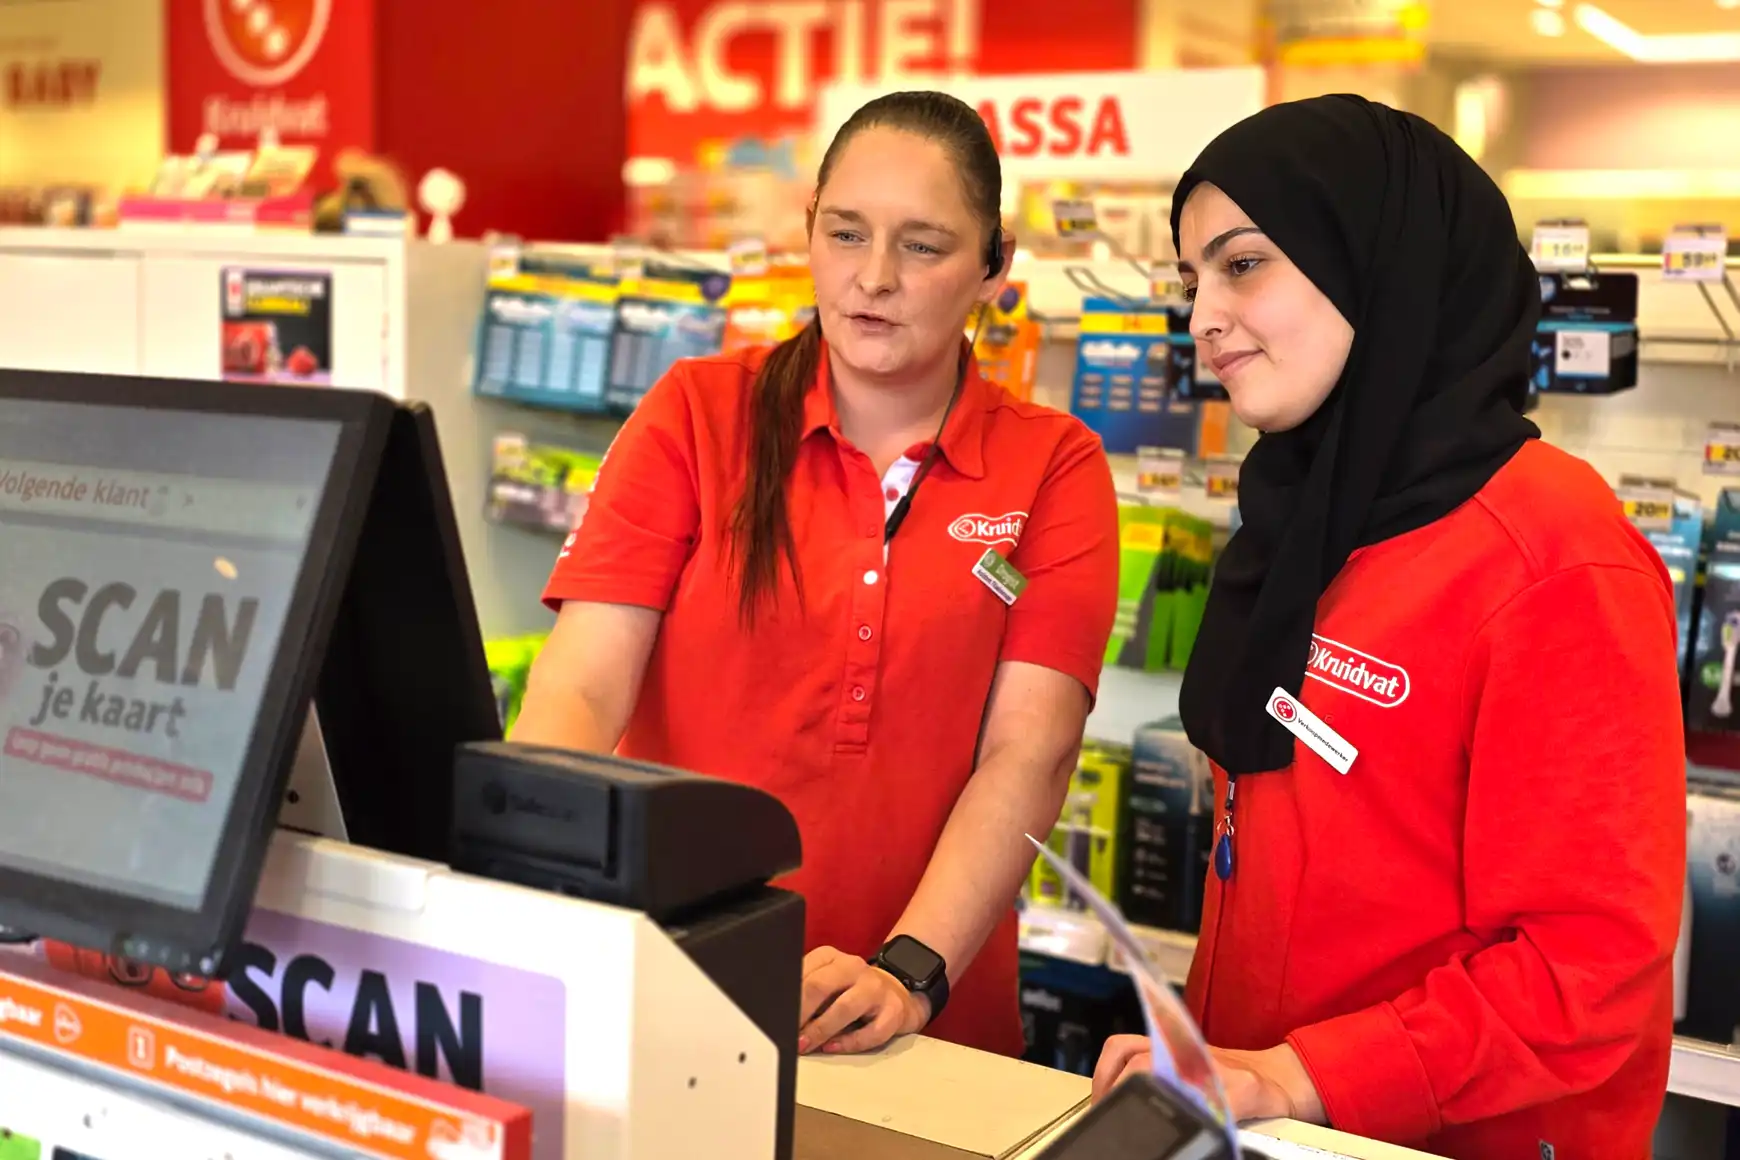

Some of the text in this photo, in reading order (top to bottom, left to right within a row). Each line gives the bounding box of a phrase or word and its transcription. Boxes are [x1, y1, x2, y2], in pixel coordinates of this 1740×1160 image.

[628, 0, 974, 112] ACTIE!
[976, 95, 1132, 157] ASSA
[92, 479, 149, 508] klant
[977, 516, 1022, 537] Kruid
[27, 577, 259, 691] SCAN
[1313, 647, 1399, 698] Kruidvat
[29, 671, 186, 738] je kaart
[1297, 717, 1348, 763] Verkoopmedewerker
[226, 940, 484, 1093] SCAN
